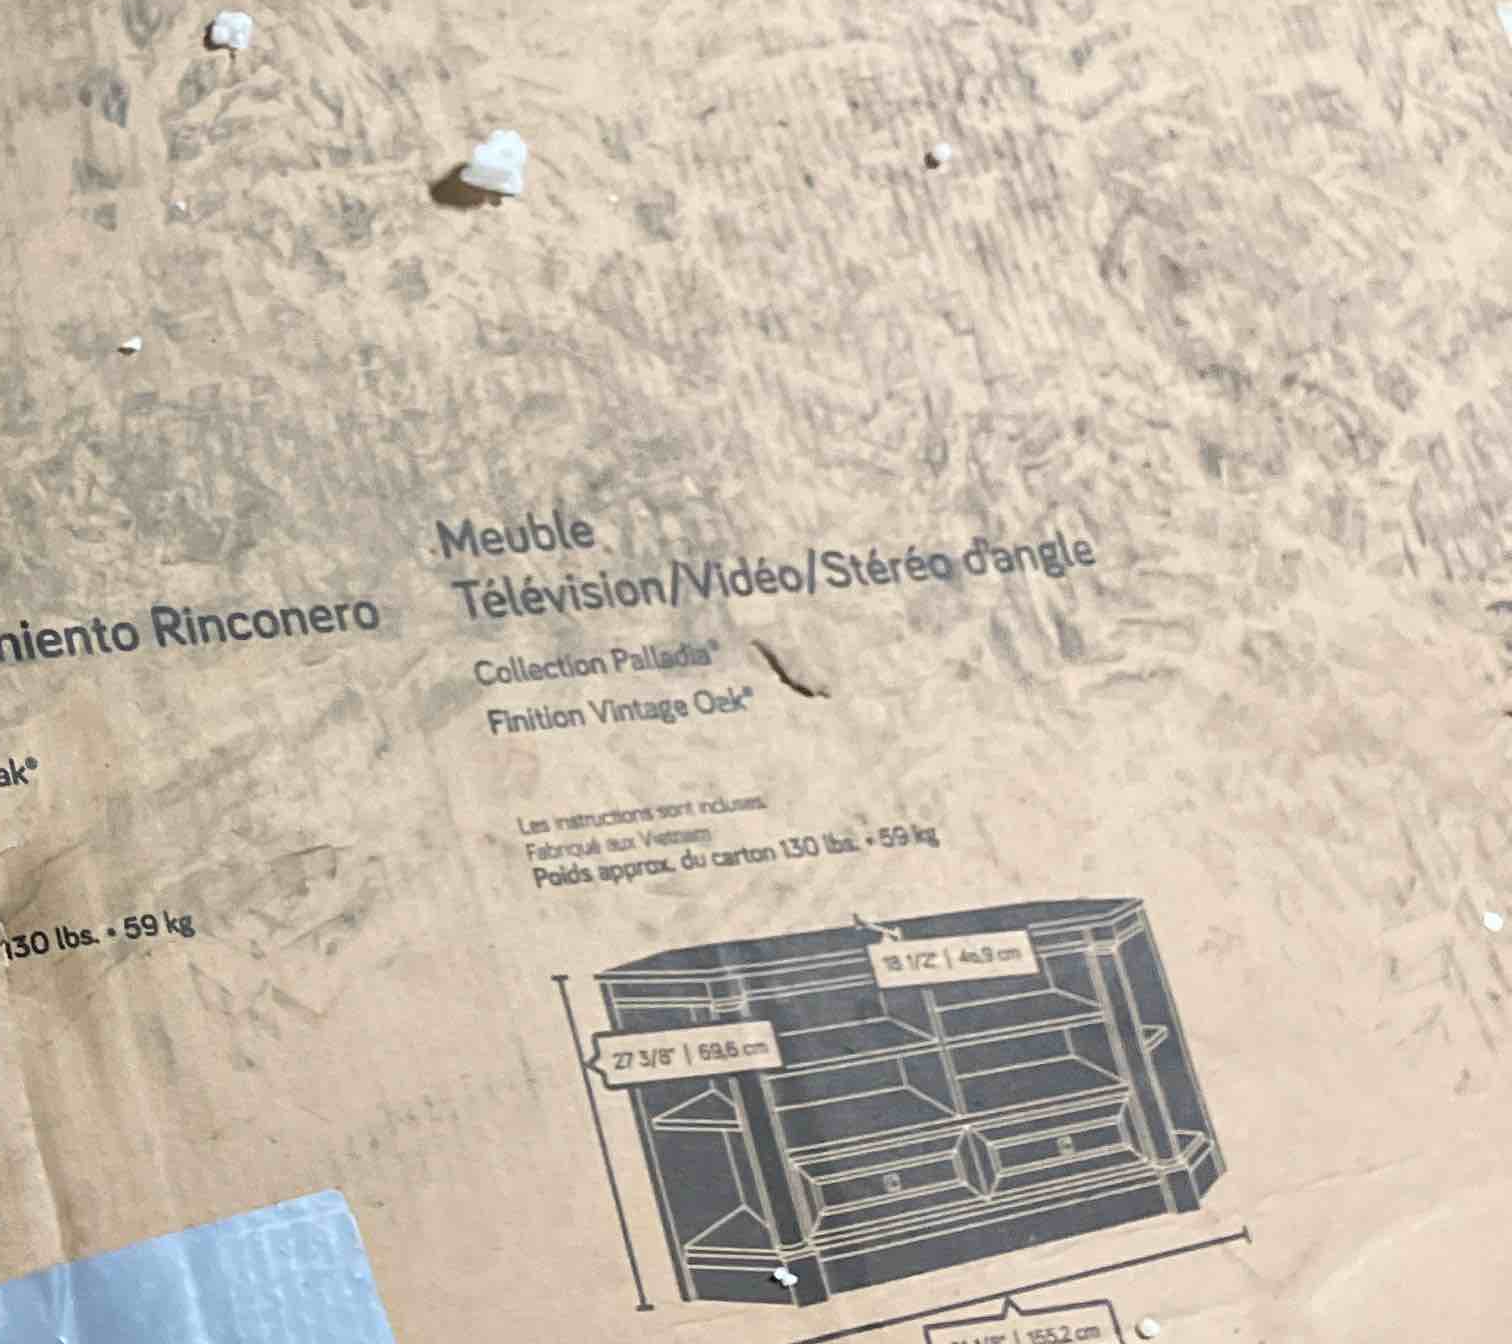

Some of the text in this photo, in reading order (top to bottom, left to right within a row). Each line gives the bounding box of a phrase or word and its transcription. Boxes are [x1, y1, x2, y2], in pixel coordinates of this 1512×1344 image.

[437, 511, 595, 558] Meuble
[452, 531, 1097, 619] Télévision/Vidéo/Stéréo d'angle
[150, 597, 380, 647] Rinconero
[474, 653, 607, 686] Collection
[488, 705, 585, 736] Finition
[589, 694, 688, 726] Vintage
[533, 864, 594, 888] Poids
[598, 857, 675, 884] approx.
[681, 849, 707, 870] du
[712, 843, 777, 866] carton
[780, 836, 818, 860] 130
[879, 826, 909, 848] 59
[913, 822, 940, 848] kg
[0, 930, 48, 960] 130
[55, 927, 100, 952] lbs.
[123, 914, 158, 939] 59
[163, 910, 196, 937] kg
[613, 1051, 632, 1070] 27
[742, 1042, 769, 1056] cm
[1075, 1326, 1100, 1341] cm
